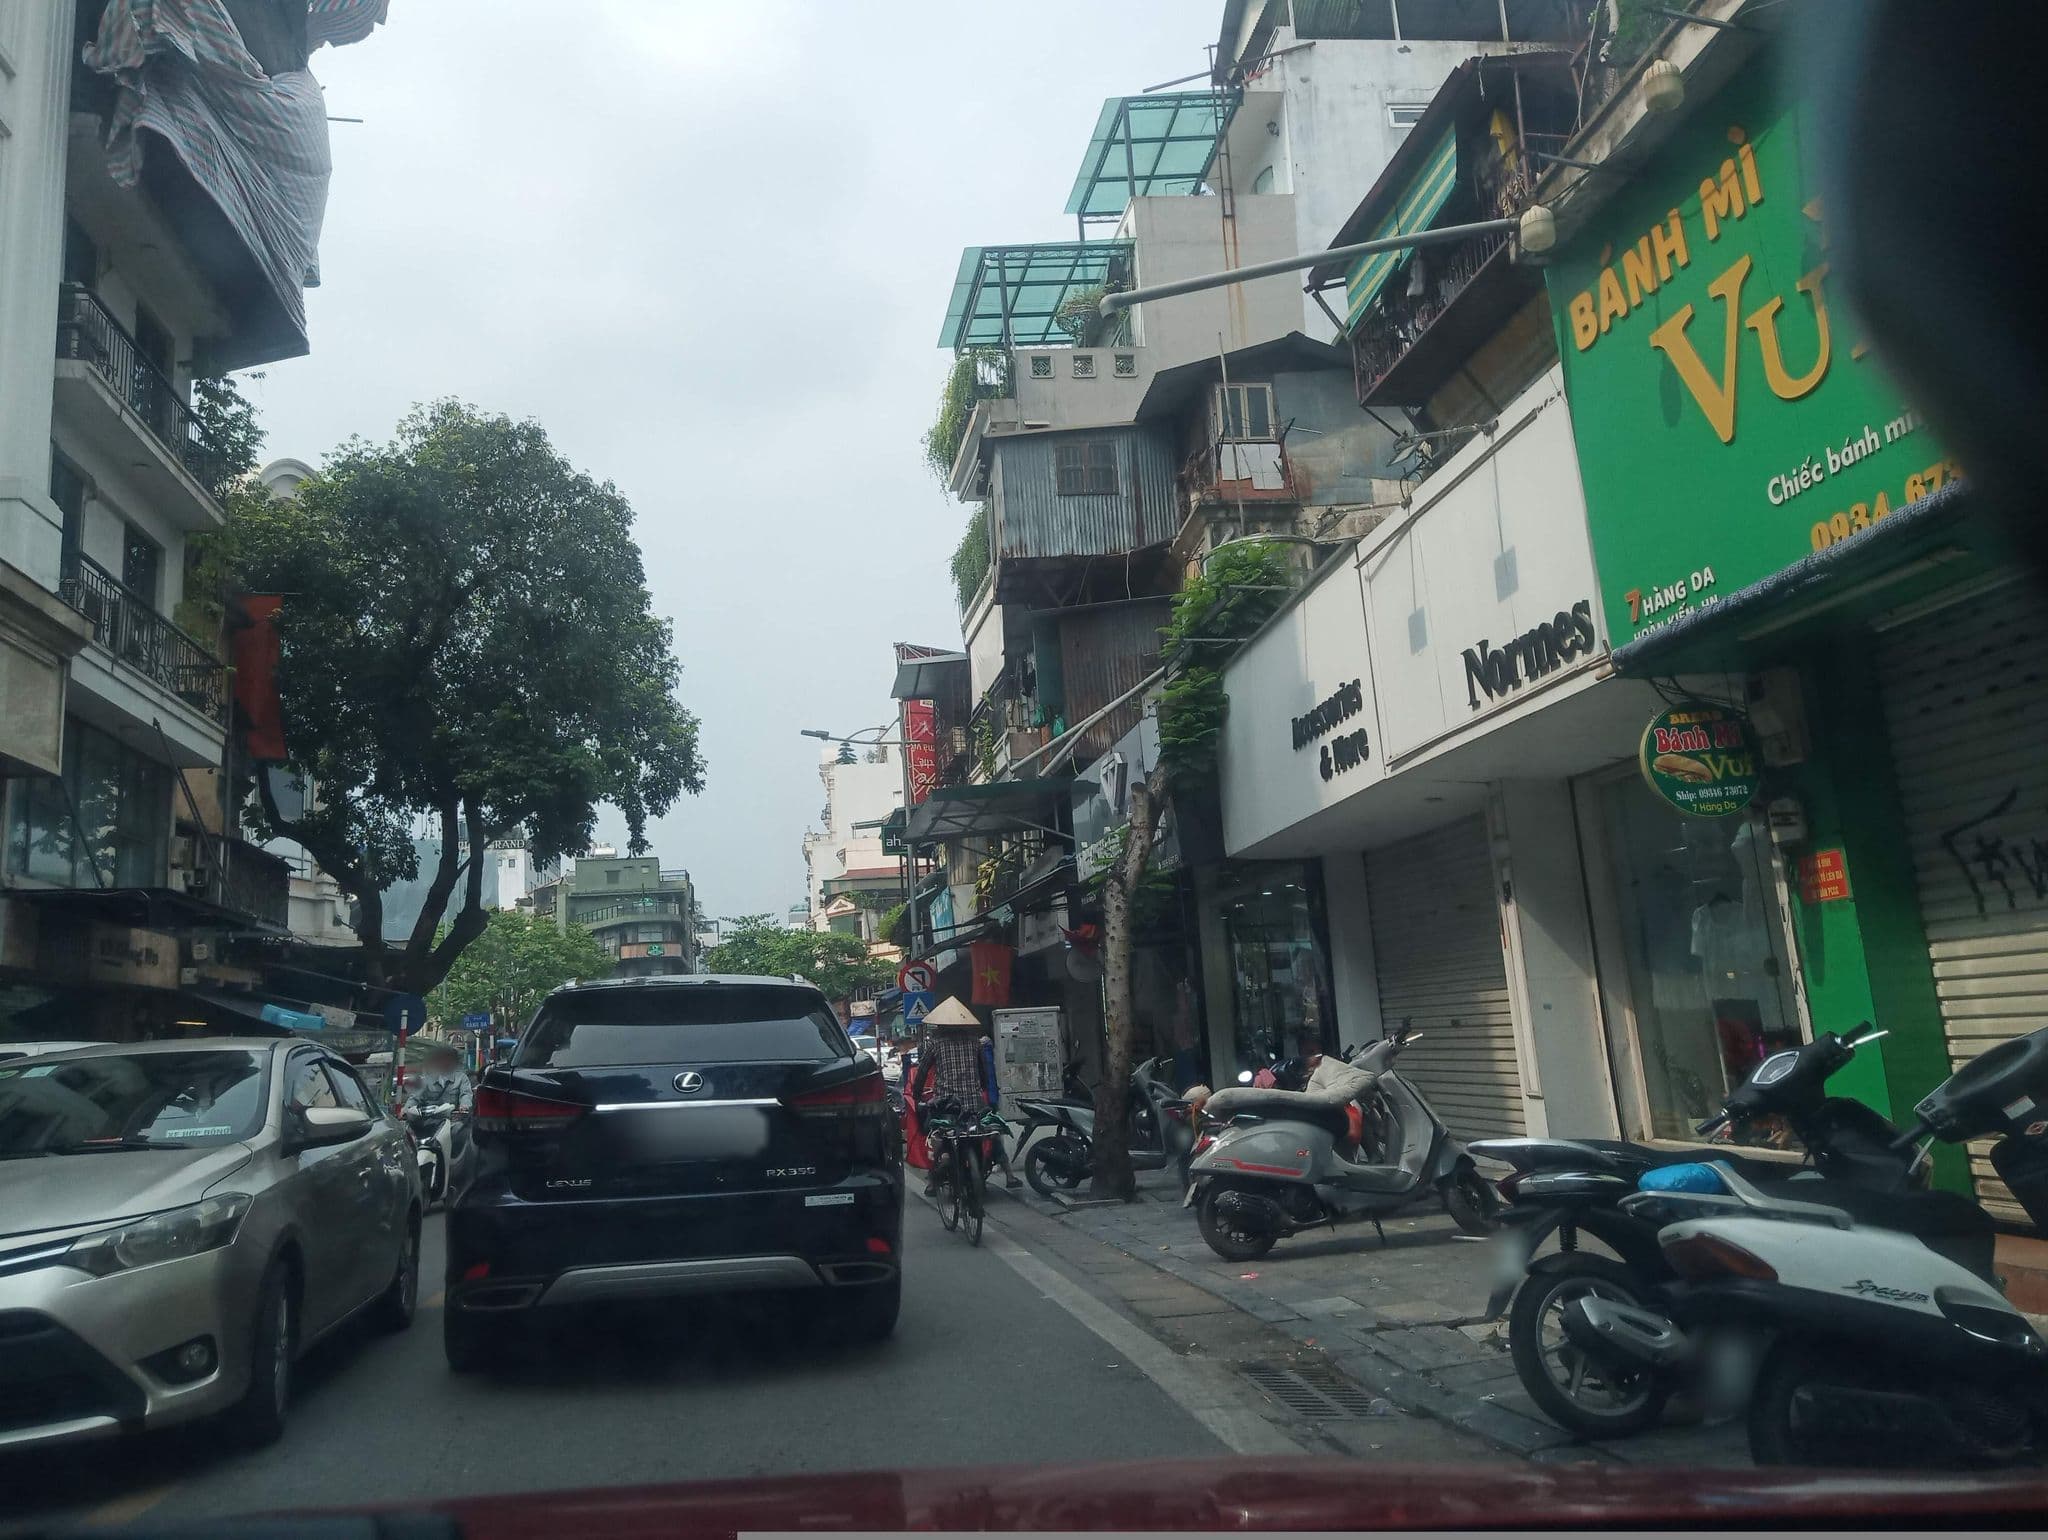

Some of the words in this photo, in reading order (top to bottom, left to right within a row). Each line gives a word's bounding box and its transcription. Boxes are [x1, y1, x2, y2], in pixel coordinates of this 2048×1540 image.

[1569, 243, 1690, 351] BÁNH
[1699, 125, 1763, 240] MÌ
[1767, 456, 1824, 505] Chiếc
[1826, 425, 1880, 474] bánh
[1625, 589, 1639, 622] 7
[1643, 580, 1686, 616] HÀNG
[1690, 566, 1715, 591] DA
[1460, 600, 1595, 712] Normes
[1654, 725, 1711, 754] Bánh
[1320, 745, 1334, 783] &
[1675, 789, 1697, 802] Ship:
[1692, 804, 1698, 812] 7
[546, 1179, 593, 1188] LEXUS
